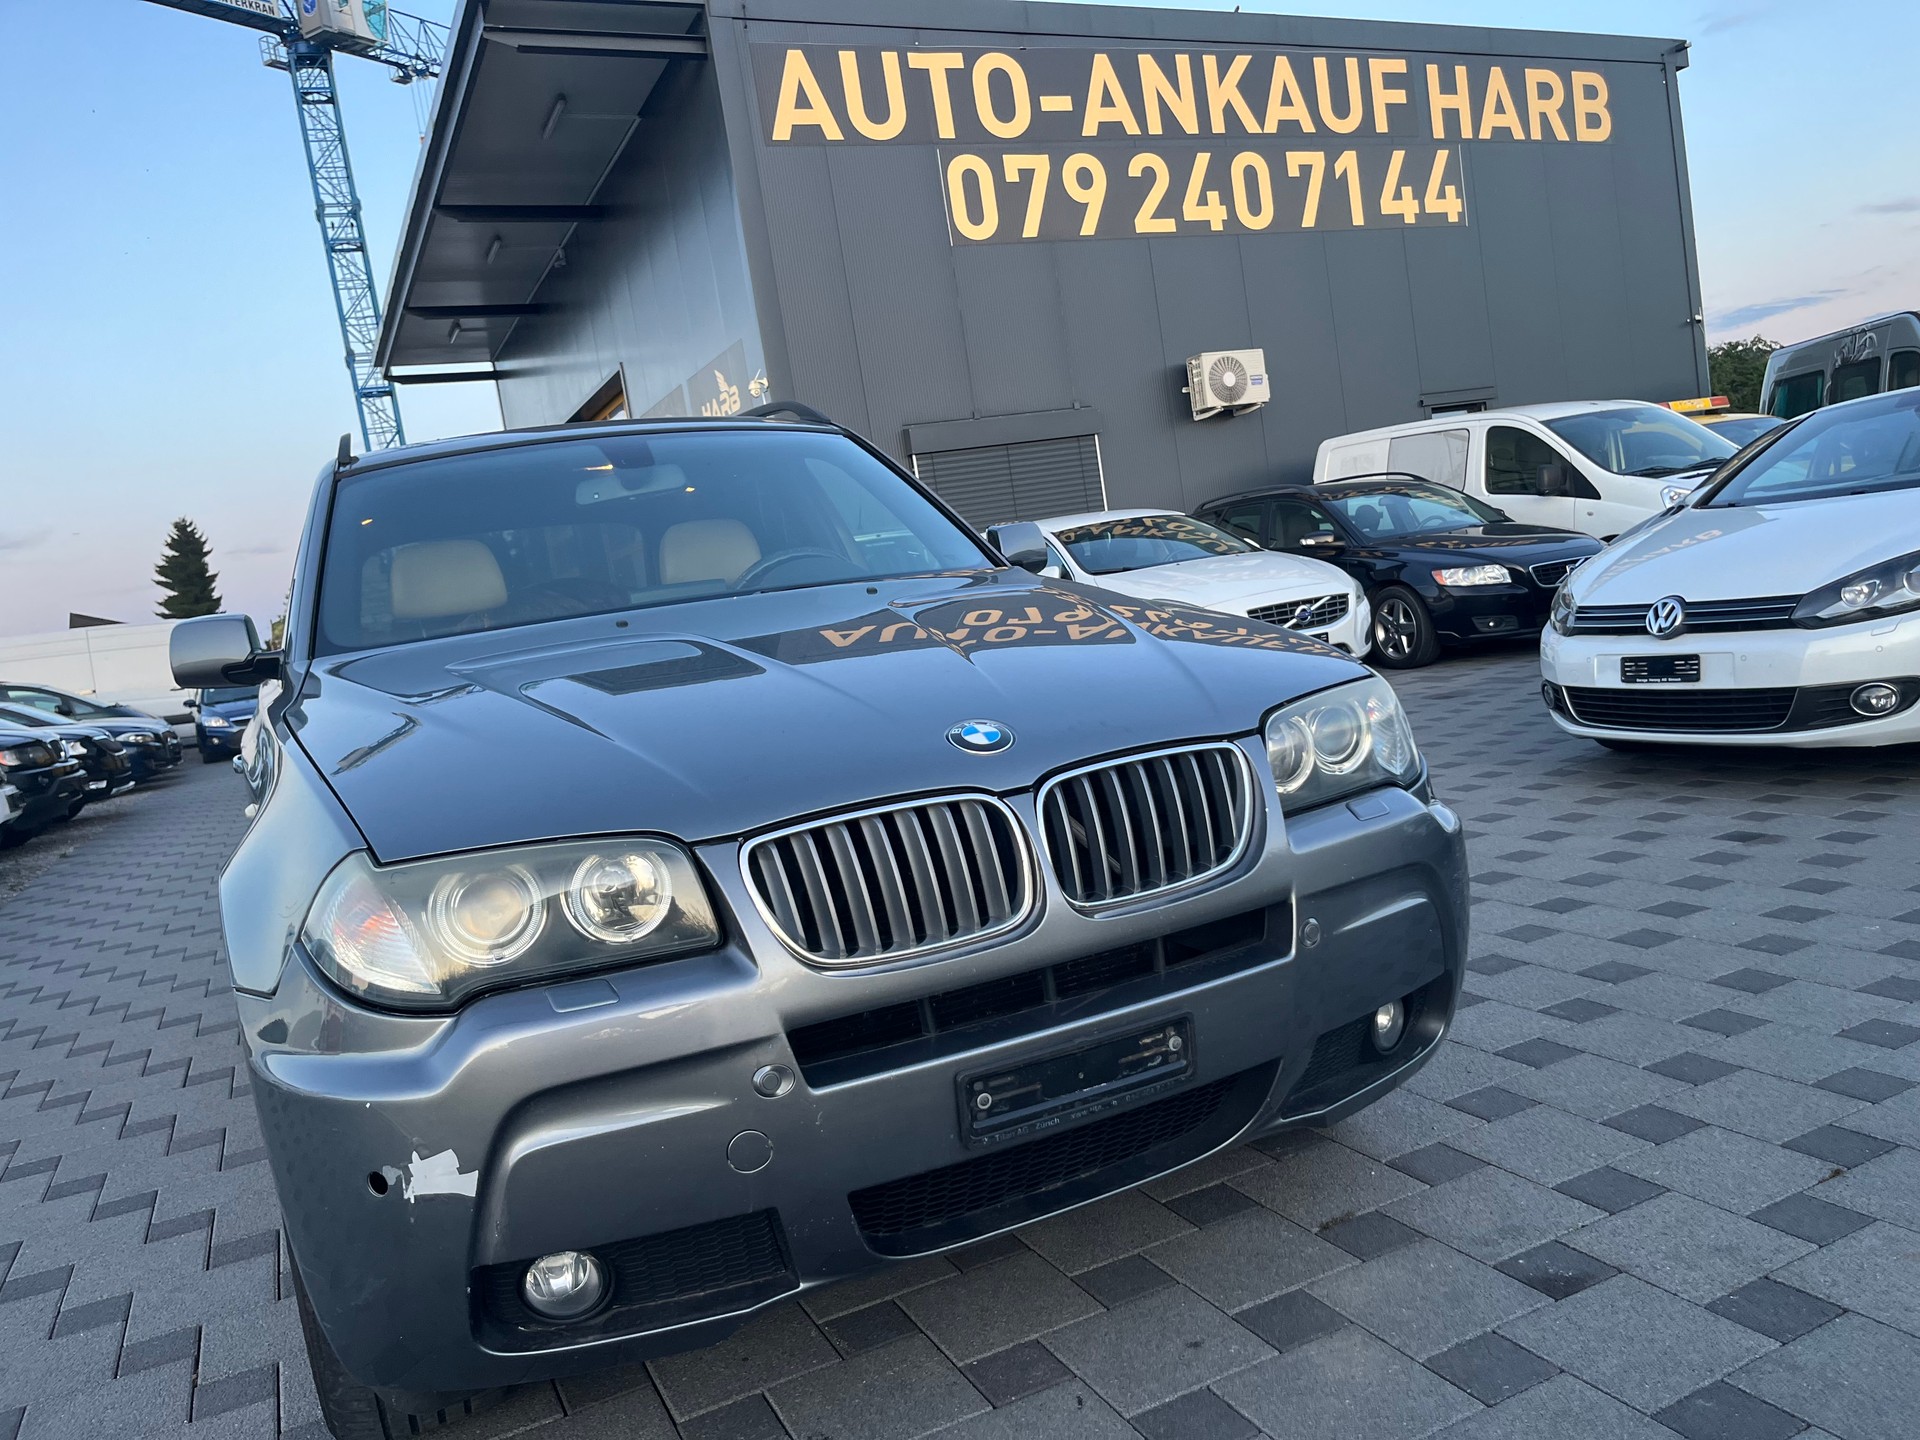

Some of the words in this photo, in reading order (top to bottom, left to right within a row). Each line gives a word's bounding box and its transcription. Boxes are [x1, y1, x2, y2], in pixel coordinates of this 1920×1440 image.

[772, 50, 1407, 142] AUTO-ANKAUF
[1426, 65, 1613, 142] HARB
[946, 151, 1108, 241] 079
[1127, 151, 1274, 234] 240
[1286, 151, 1364, 227] 71
[1380, 150, 1463, 224] 44
[702, 385, 740, 416] HARB
